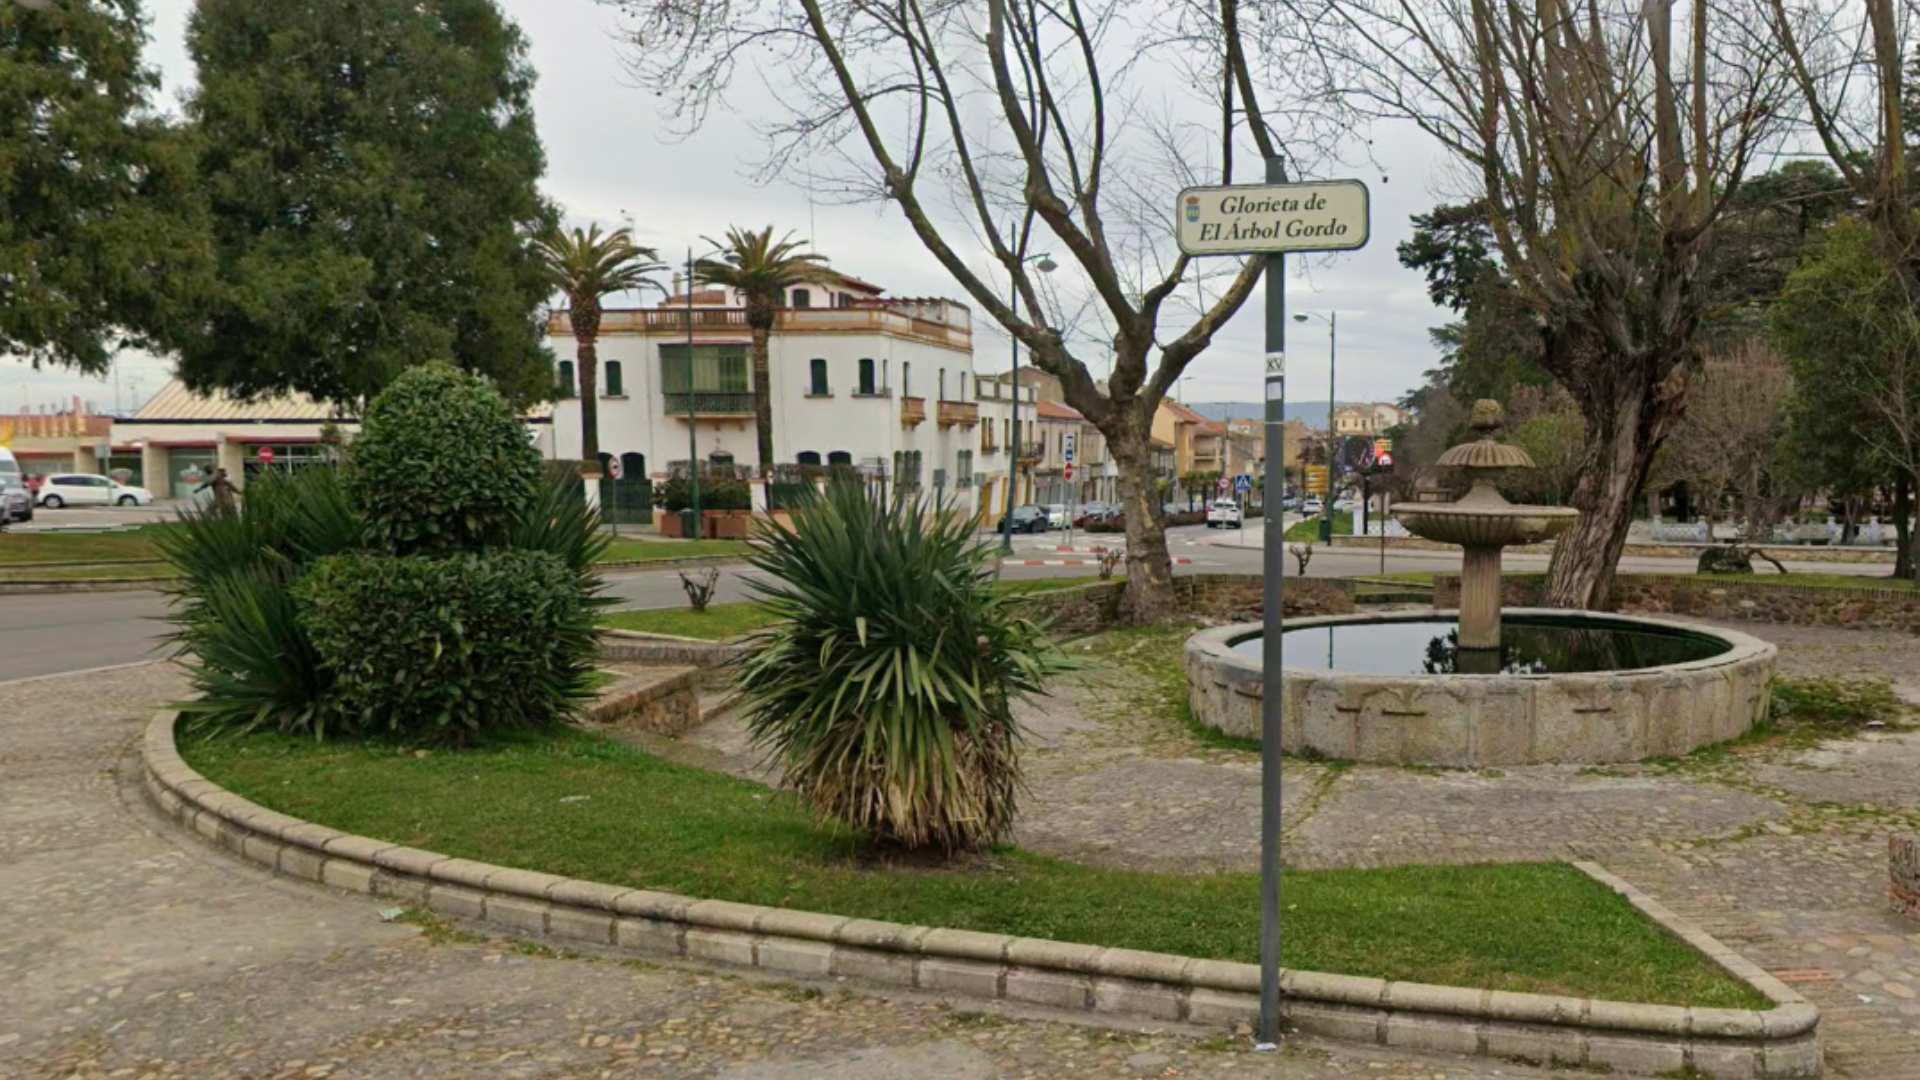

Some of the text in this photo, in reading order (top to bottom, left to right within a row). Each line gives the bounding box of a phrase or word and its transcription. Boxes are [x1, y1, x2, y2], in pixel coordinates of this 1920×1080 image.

[1219, 193, 1327, 214] Glorieta de
[1199, 217, 1348, 242] El Árbol Gordo
